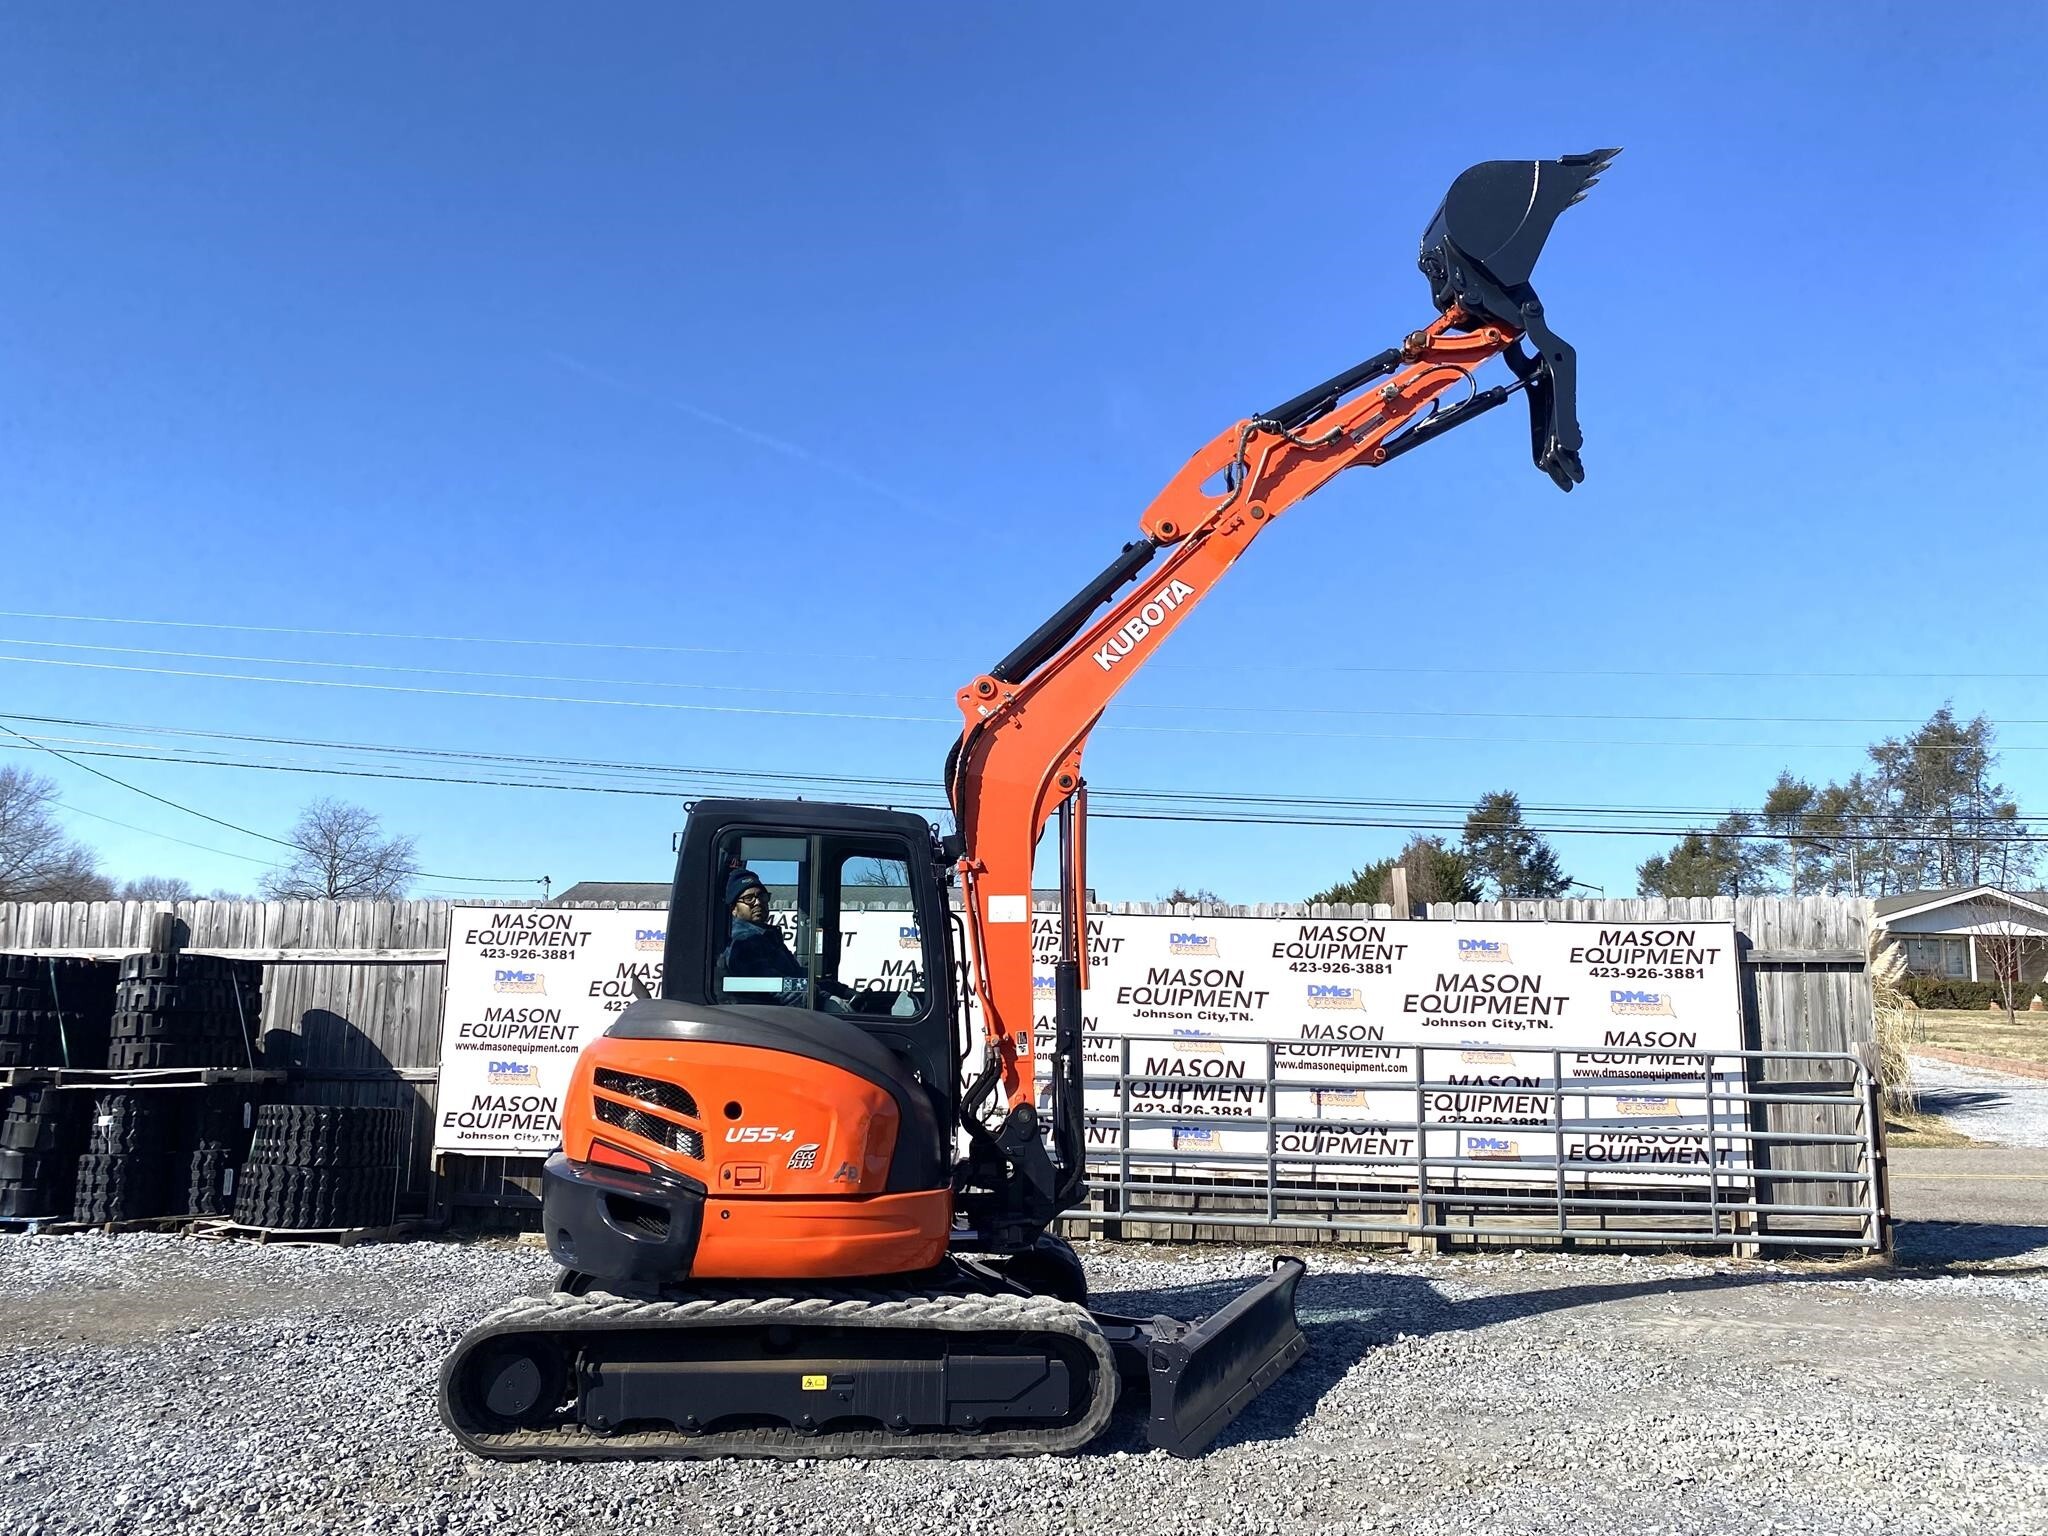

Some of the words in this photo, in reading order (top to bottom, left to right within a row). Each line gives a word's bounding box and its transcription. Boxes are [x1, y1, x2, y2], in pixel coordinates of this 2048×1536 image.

[1092, 579, 1196, 672] KUBOTA
[491, 914, 573, 930] MASON
[465, 930, 592, 947] EQUIPMENT
[1298, 925, 1386, 942] MASON
[1599, 930, 1696, 947] MASON
[480, 948, 576, 960] 423-926-3881
[1272, 942, 1408, 961] EQUIPMENT
[1569, 947, 1721, 965] EQUIPMENT
[1288, 962, 1393, 974] 423-926-3881
[1589, 967, 1704, 979] 423-926-3881
[1146, 967, 1245, 988] MASON
[1435, 973, 1542, 994] MASON
[1116, 986, 1270, 1009] EQUIPMENT
[1403, 994, 1570, 1016] EQUIPMENT
[484, 1007, 562, 1023] MASON
[1133, 1009, 1193, 1020] Johnson
[1421, 1017, 1487, 1029] Johnson
[459, 1023, 580, 1041] EQUIPMENT
[1300, 1024, 1384, 1041] MASON
[1604, 1031, 1697, 1048] MASON
[455, 1042, 579, 1055] www.dmasonequipment.com
[1144, 1057, 1246, 1080] MASON
[1572, 1068, 1724, 1081] www.dmasonequipment.cm
[472, 1095, 558, 1112] MASON
[442, 1112, 562, 1131] EQUIPMEN
[457, 1131, 510, 1141] Johnson
[725, 1127, 796, 1143] U55-4
[795, 1151, 816, 1160] eco
[1568, 1143, 1733, 1166] EQUIPMENT
[787, 1159, 814, 1169] PLUS
